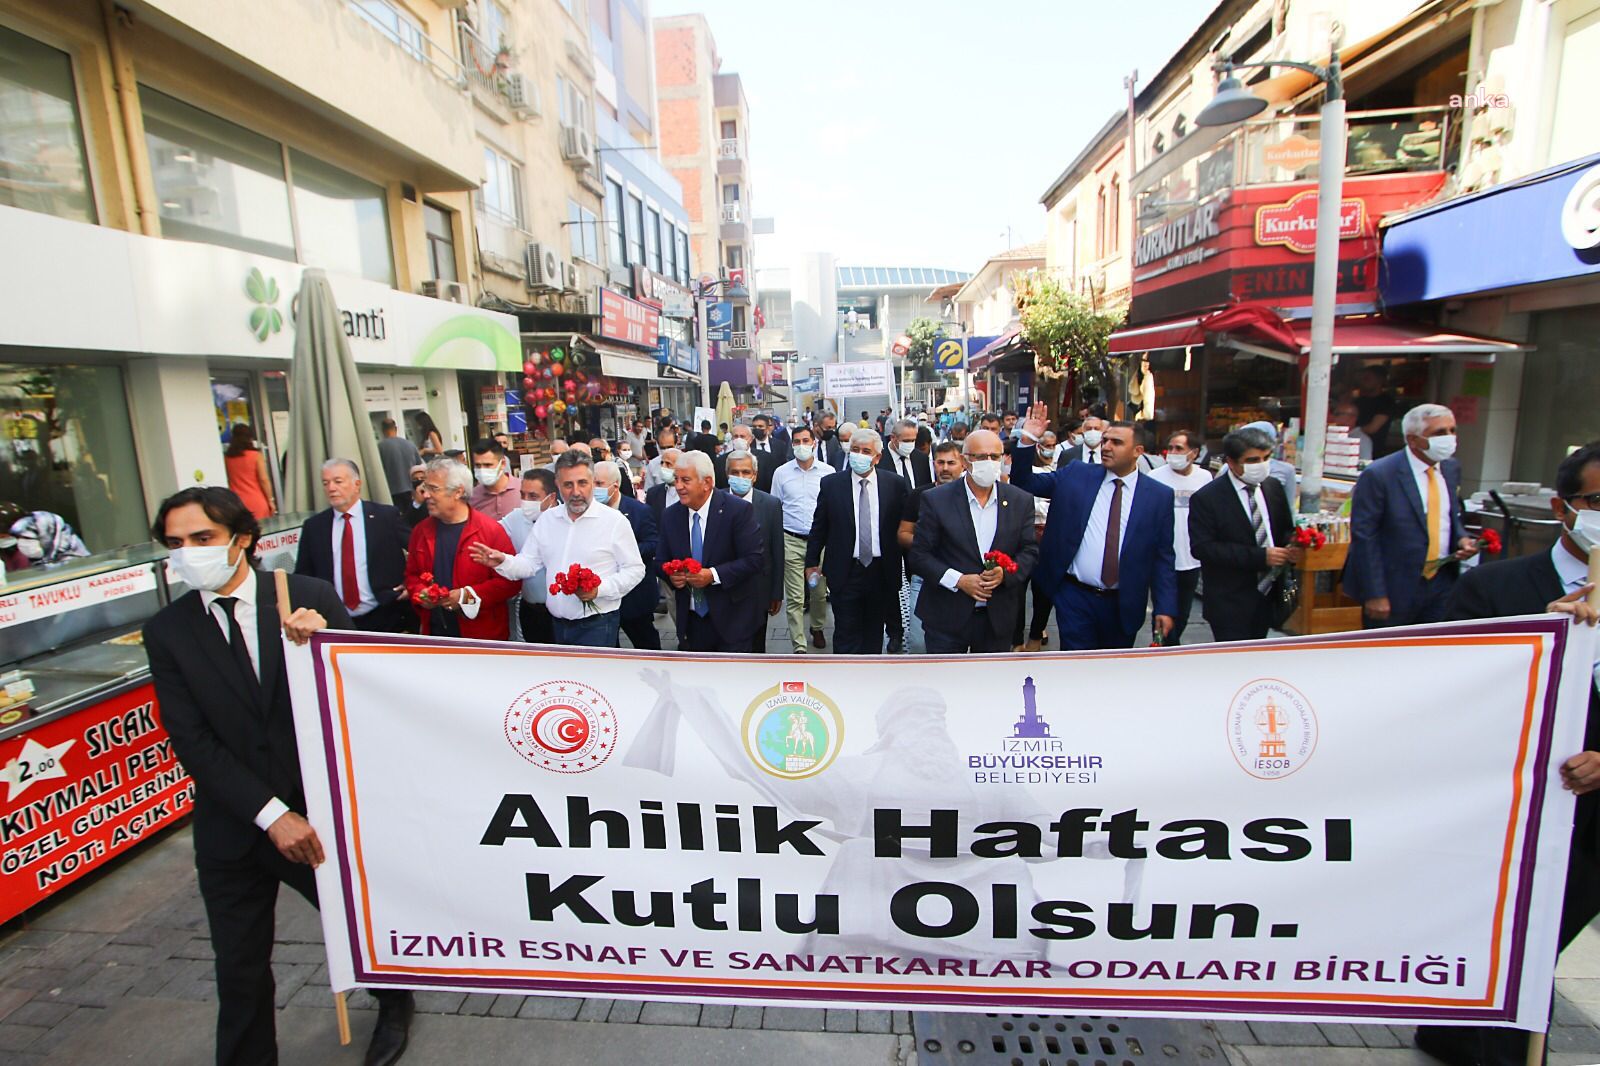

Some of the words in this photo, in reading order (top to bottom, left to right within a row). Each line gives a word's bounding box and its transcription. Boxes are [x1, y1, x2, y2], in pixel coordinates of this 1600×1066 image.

[1135, 204, 1219, 268] KURKUTLAR
[28, 585, 81, 609] TAVUKLU
[84, 701, 158, 759] SICAK
[1002, 739, 1063, 752] İZMİR
[968, 752, 1103, 770] BÜYÜKŞEHİR
[975, 771, 1096, 784] BELEDİYESİ
[1254, 758, 1290, 769] İESOB
[0, 763, 122, 844] KIYMALI
[126, 737, 176, 780] PEY
[2, 829, 69, 875] ÖZEL
[37, 839, 105, 891] NOT:
[111, 799, 171, 850] AÇIK
[479, 793, 826, 856] Ahilik
[873, 808, 1353, 862] Haftası
[525, 872, 840, 935] Kutlu
[889, 880, 1299, 940] Olsun.
[389, 929, 507, 959] İZMİR
[519, 940, 646, 967] ESNAF
[660, 948, 714, 969] VE
[727, 951, 1064, 979] SANATKARLAR
[1067, 959, 1275, 982] ODALARI
[1294, 954, 1466, 987] BİRLİĞİ
